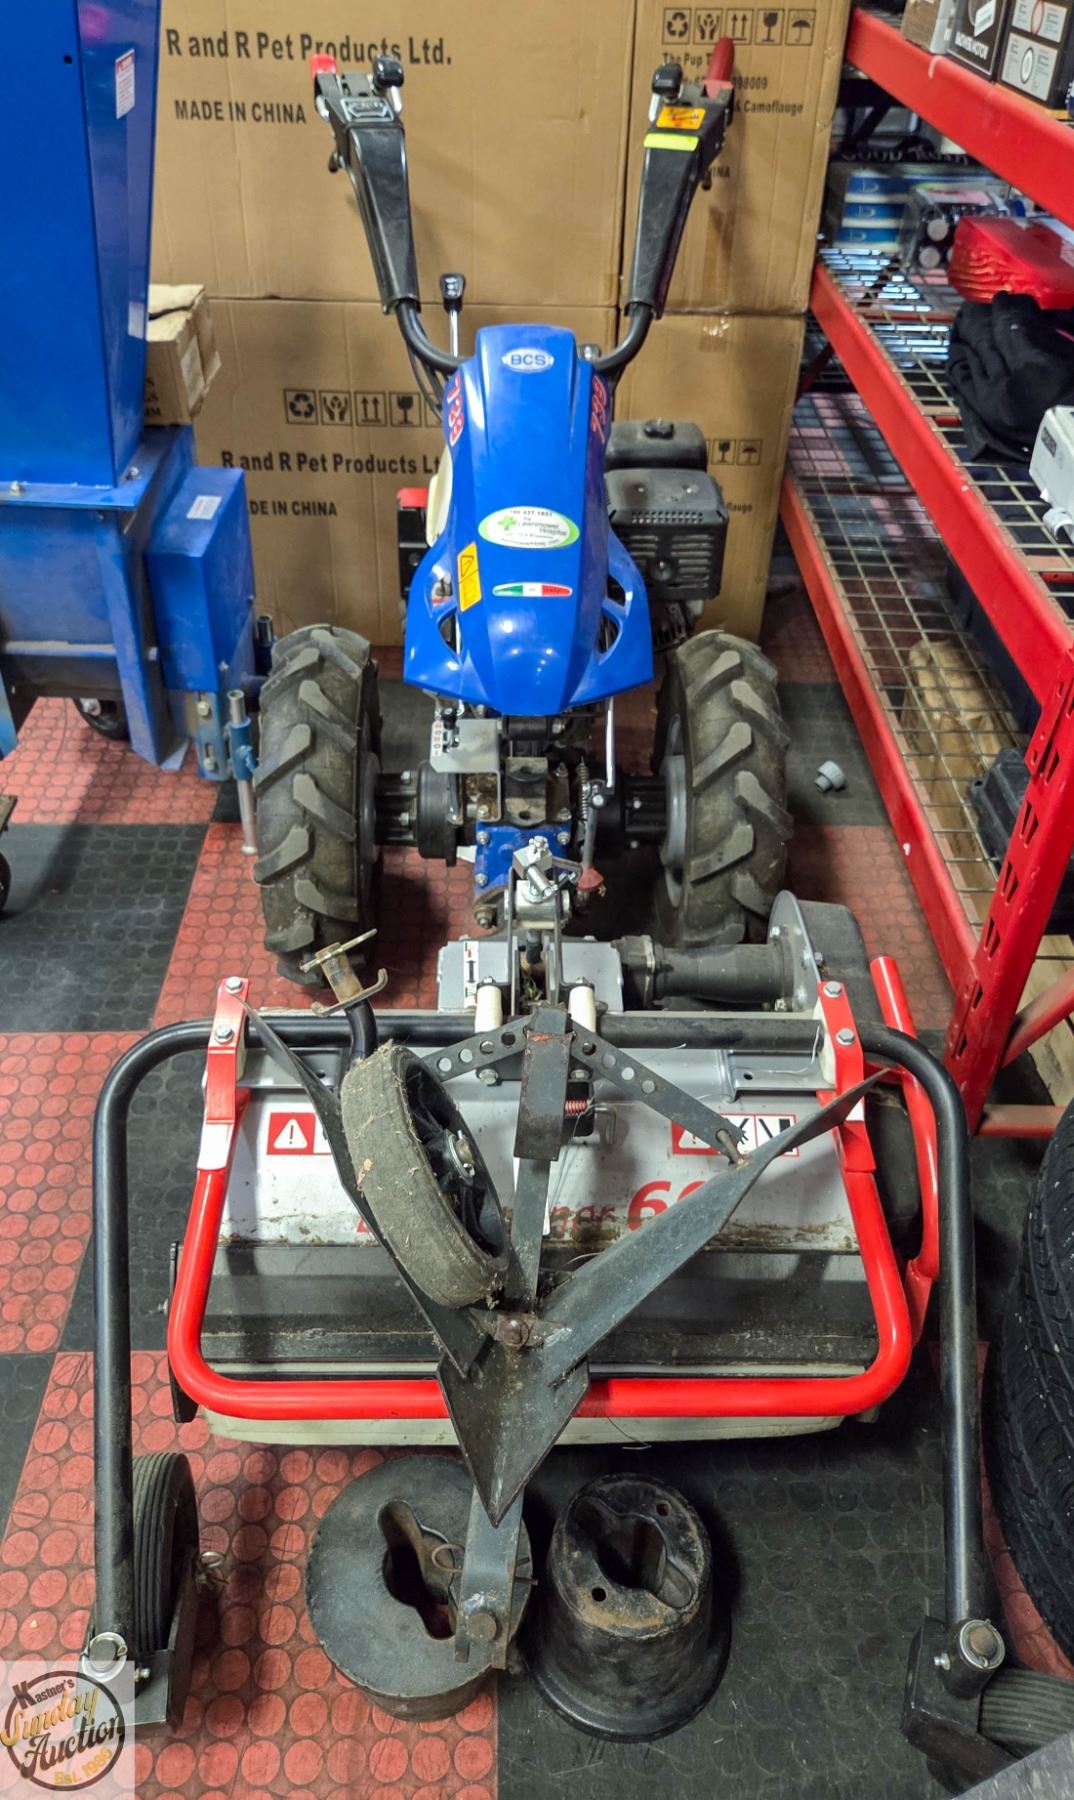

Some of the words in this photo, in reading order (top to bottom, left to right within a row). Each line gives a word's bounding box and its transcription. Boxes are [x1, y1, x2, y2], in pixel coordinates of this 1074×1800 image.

[166, 28, 182, 56] R
[188, 30, 229, 58] and
[235, 31, 251, 59] R
[256, 32, 294, 60] Pet
[408, 36, 452, 65] Ltd.
[174, 99, 224, 121] MADE
[228, 101, 246, 121] IN
[251, 102, 307, 124] CHINA
[511, 353, 546, 366] BCS
[221, 450, 235, 469] R
[240, 450, 274, 471] and
[279, 451, 293, 472] R
[296, 452, 328, 472] Pet
[333, 454, 417, 474] Products
[273, 500, 288, 516] IN
[291, 502, 337, 517] CHINA
